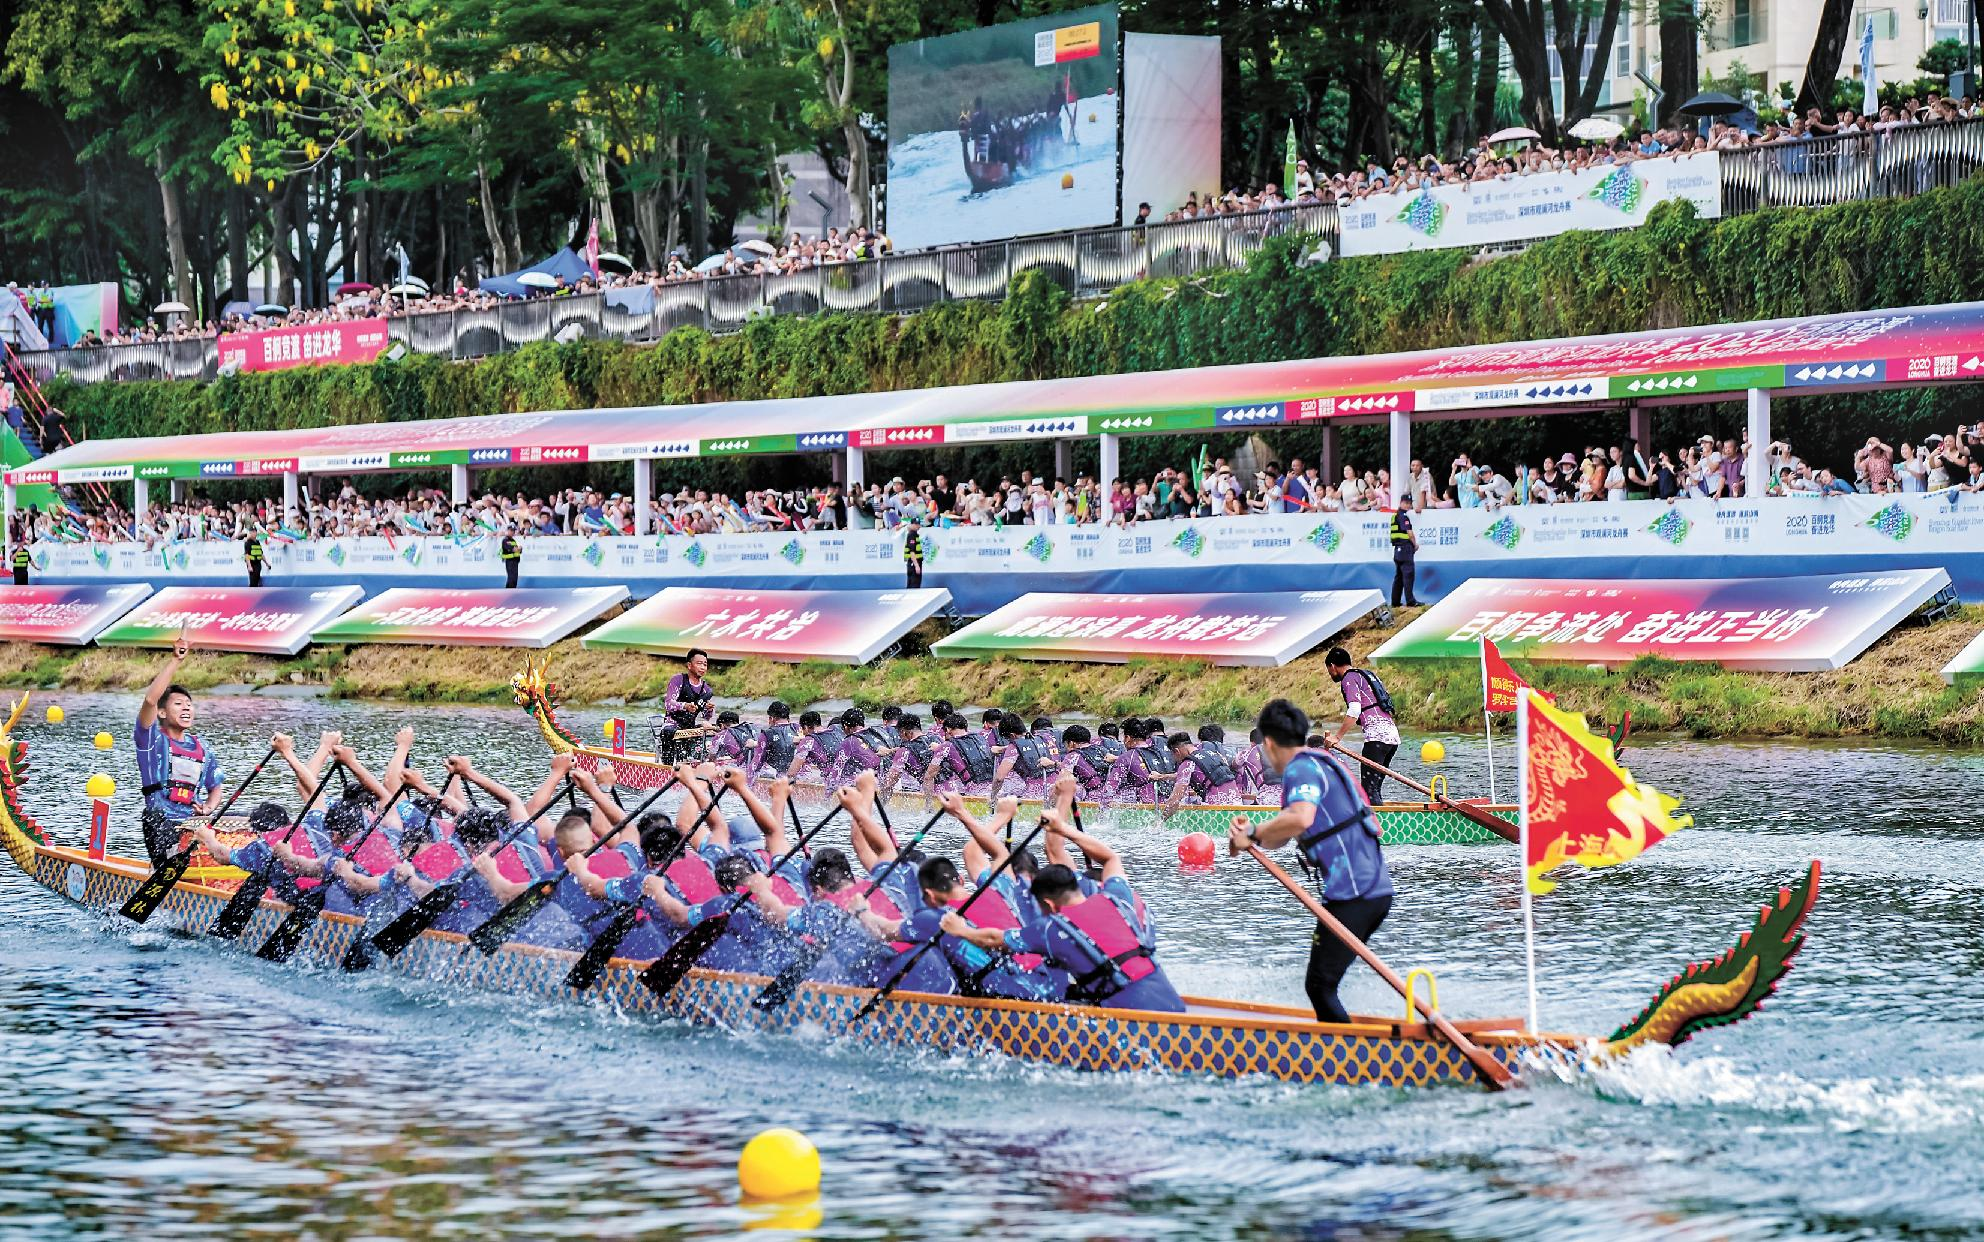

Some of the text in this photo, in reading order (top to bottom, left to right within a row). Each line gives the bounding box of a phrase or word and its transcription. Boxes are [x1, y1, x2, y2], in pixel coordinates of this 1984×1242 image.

[262, 333, 300, 363] 百舸竞渡
[303, 328, 342, 358] 奋进龙华
[1909, 357, 1931, 370] 2020
[1786, 515, 1808, 527] 2020
[678, 609, 820, 642] 六水共治
[1445, 606, 1829, 644] 百舸争流处 奋进正当时
[616, 726, 622, 748] 3
